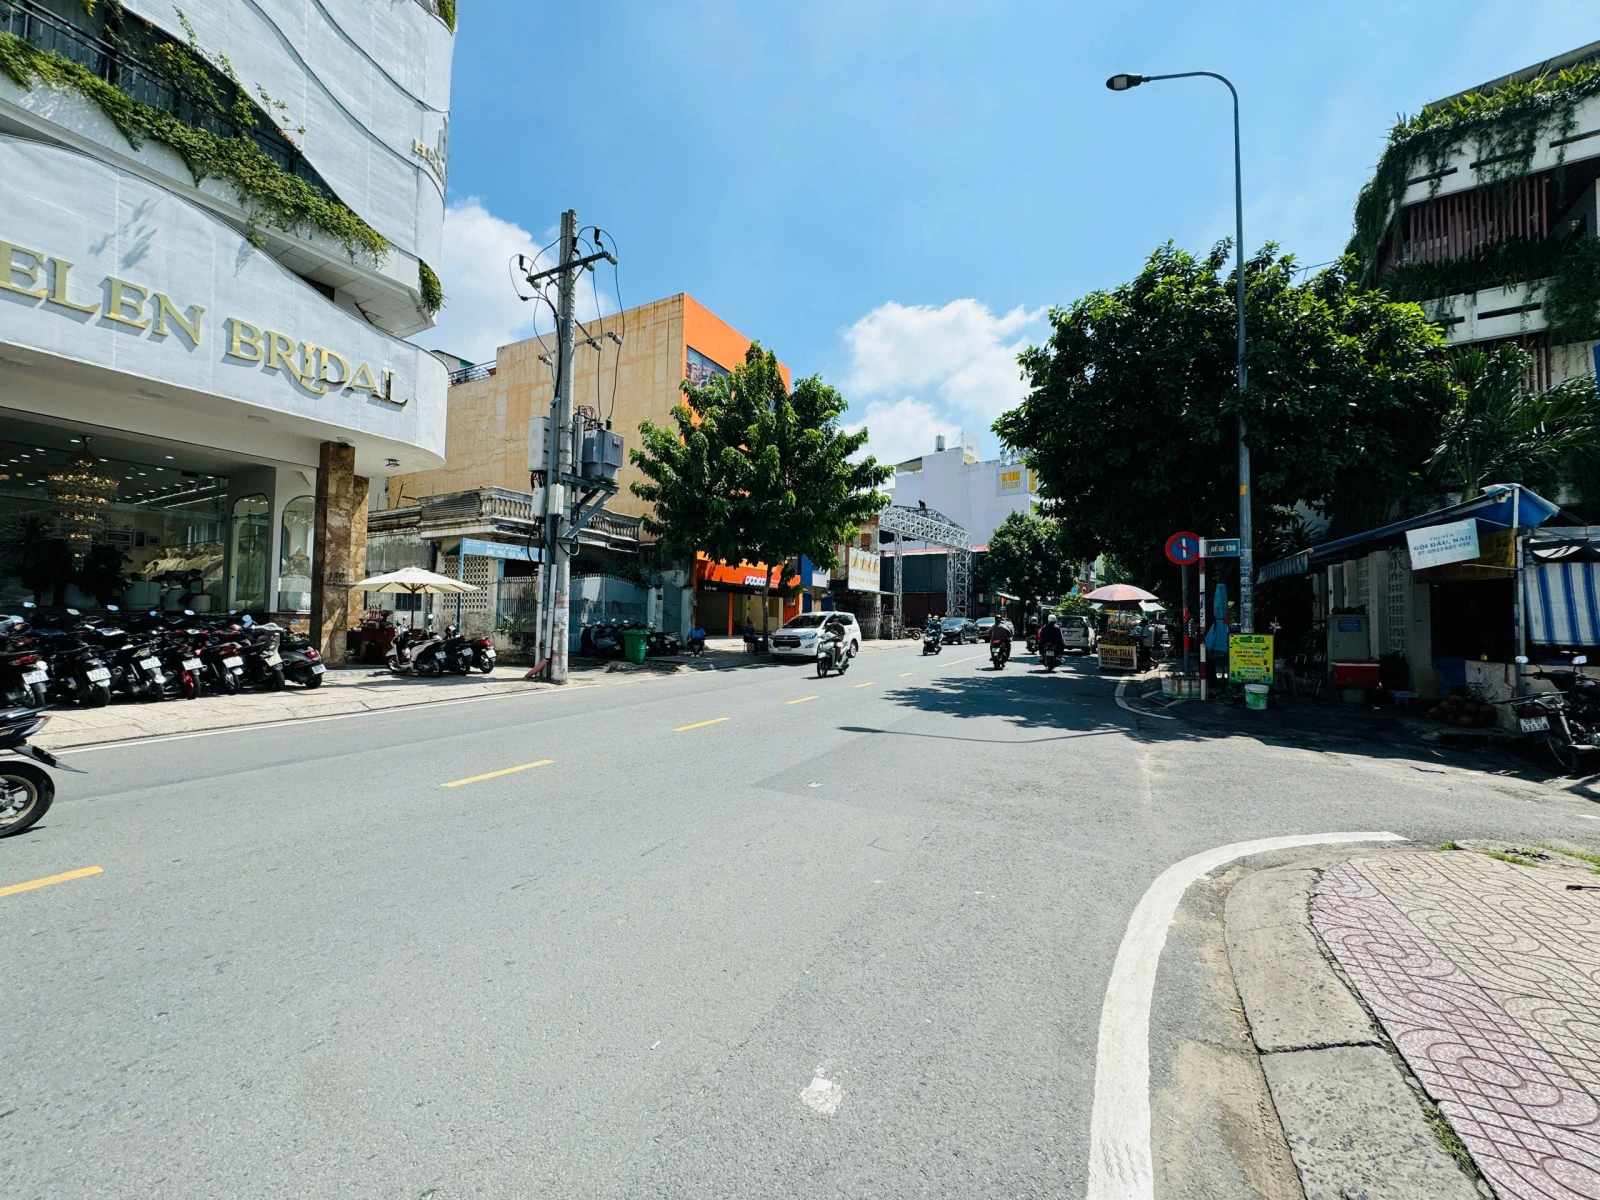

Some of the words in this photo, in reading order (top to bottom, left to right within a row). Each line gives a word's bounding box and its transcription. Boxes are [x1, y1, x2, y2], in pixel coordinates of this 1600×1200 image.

[227, 317, 409, 407] BRIDAL
[1001, 470, 1021, 483] KUB
[1001, 481, 1021, 491] STUDIO
[1453, 535, 1473, 543] NAIL
